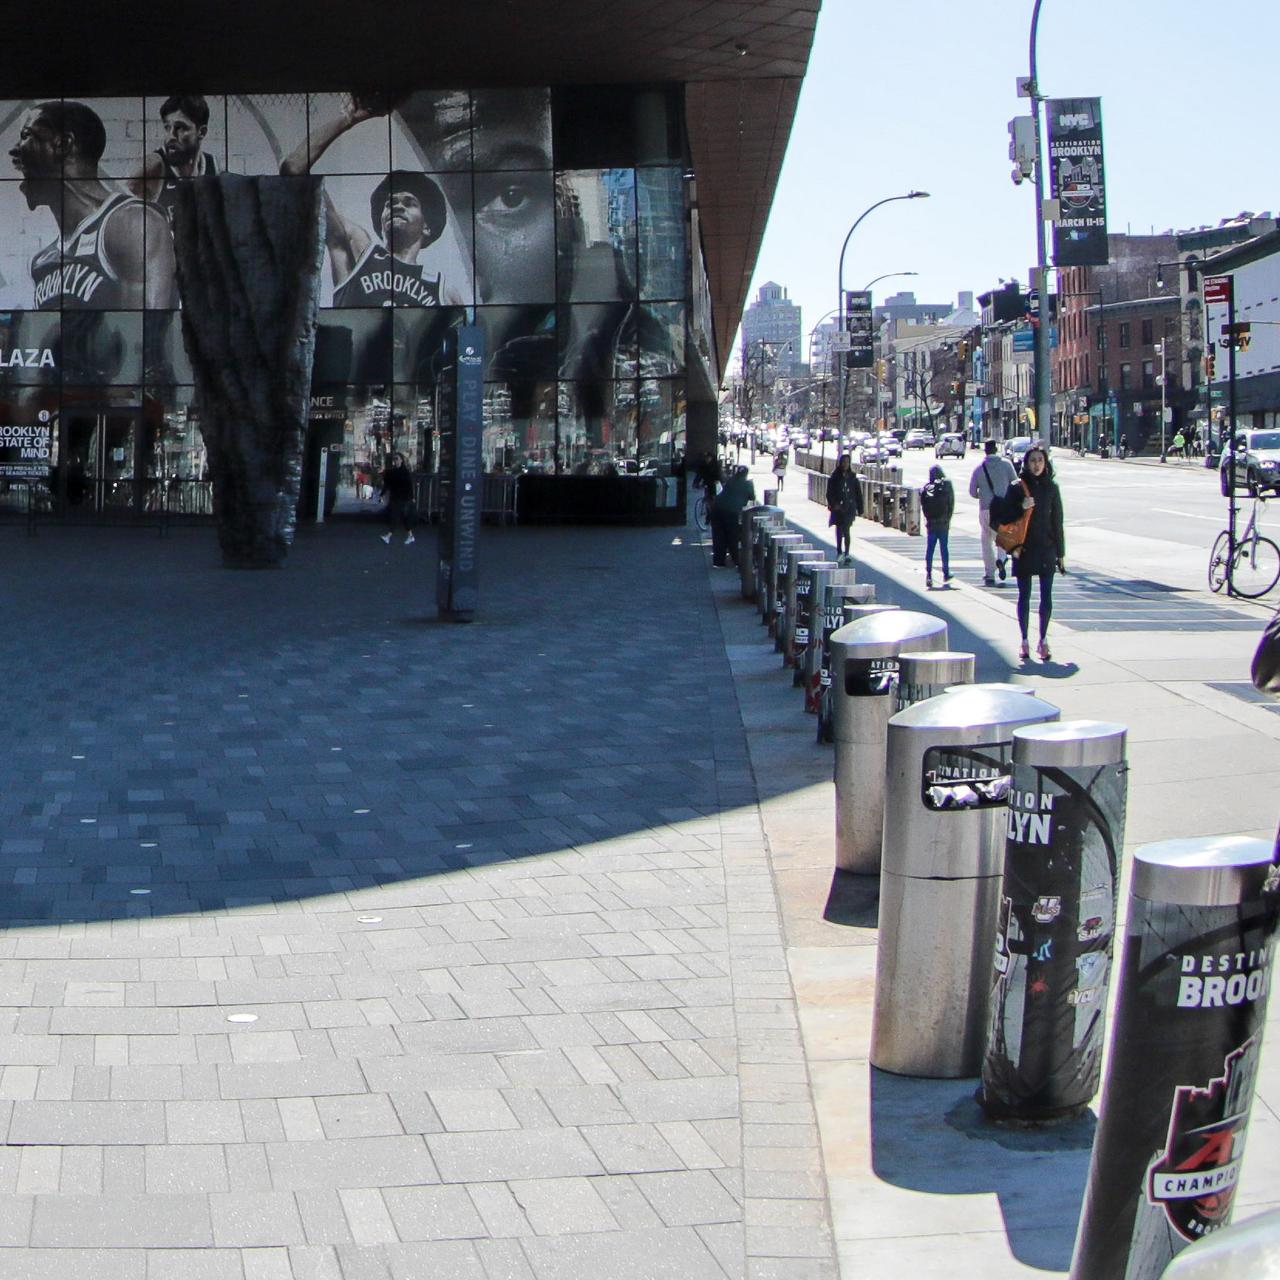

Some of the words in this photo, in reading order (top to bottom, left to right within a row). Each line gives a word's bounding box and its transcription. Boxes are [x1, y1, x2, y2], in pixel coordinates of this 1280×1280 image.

[1051, 145, 1102, 157] BROOKLYN
[34, 263, 104, 310] ROOKLYN
[360, 270, 437, 307] BROOKLYN
[461, 379, 477, 423] PLAY
[21, 448, 49, 459] MIND
[33, 437, 50, 448] OF
[460, 436, 476, 480] DINE
